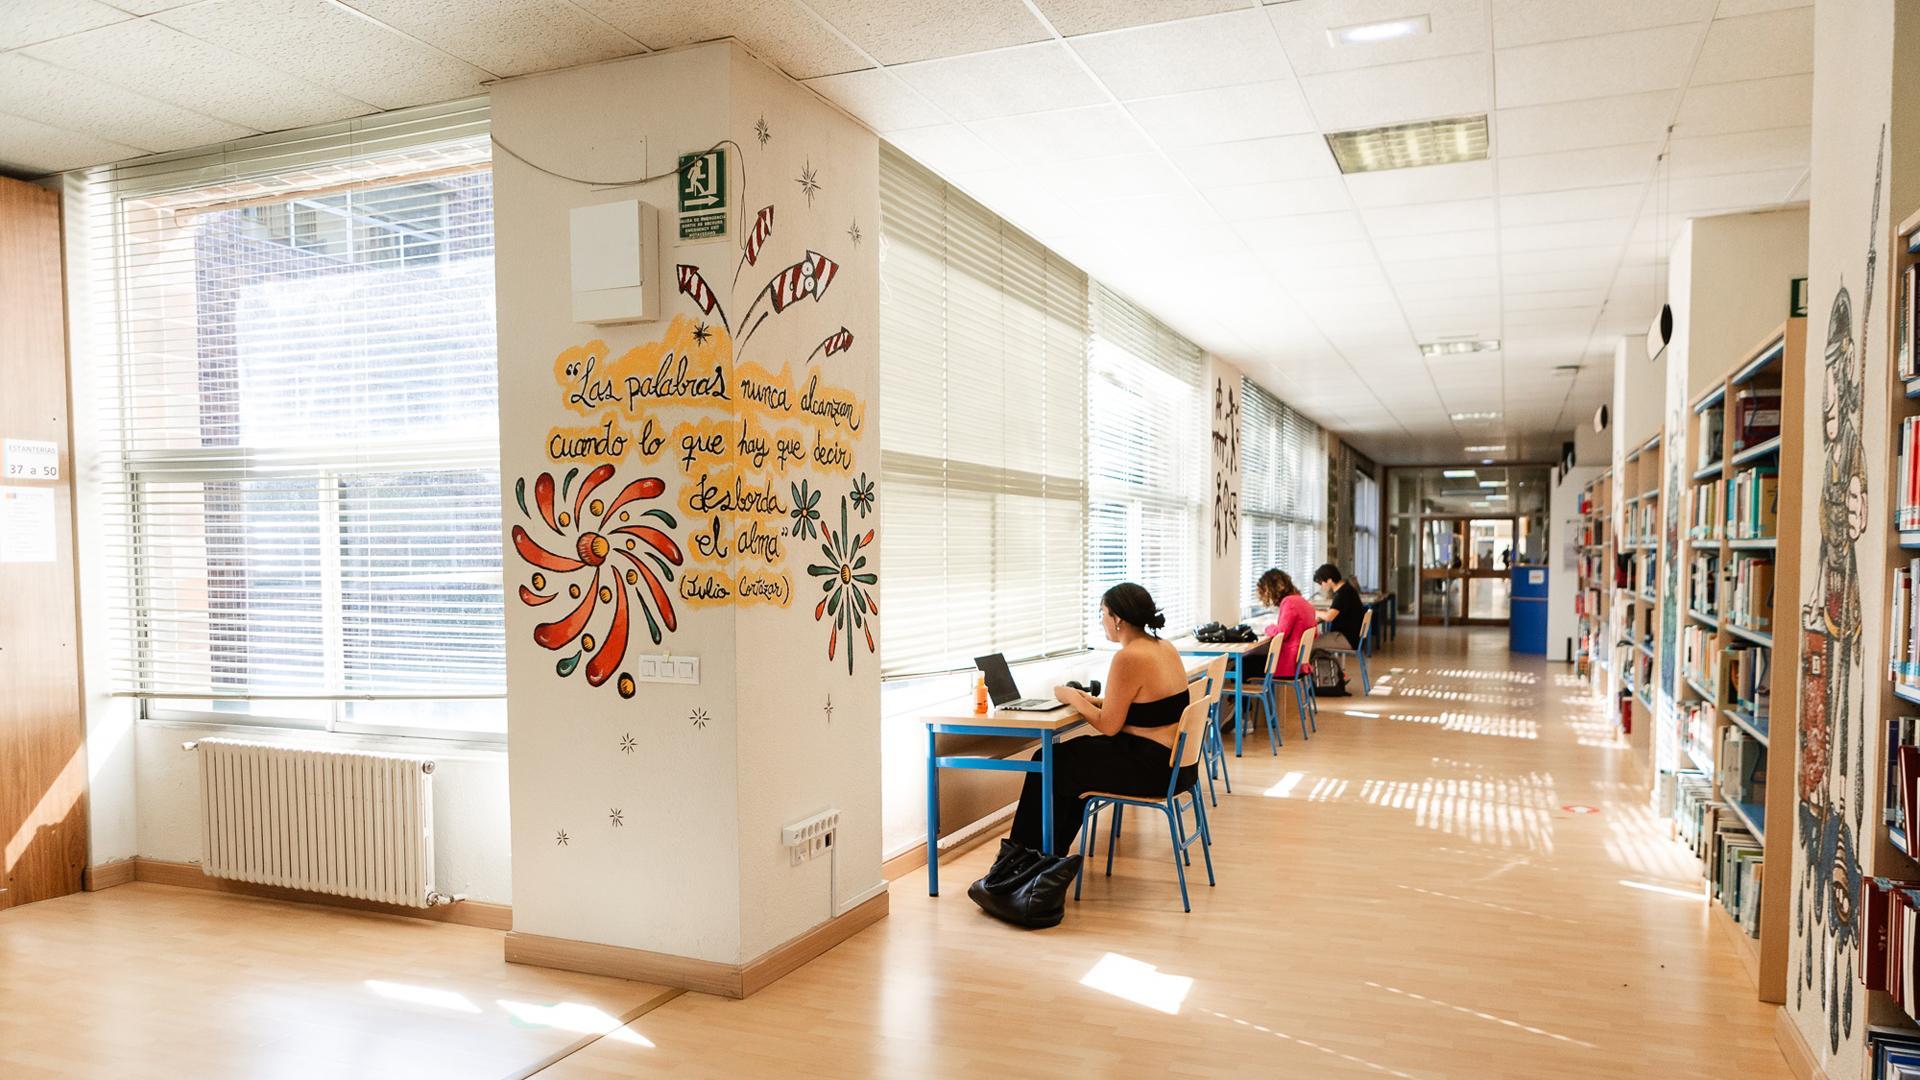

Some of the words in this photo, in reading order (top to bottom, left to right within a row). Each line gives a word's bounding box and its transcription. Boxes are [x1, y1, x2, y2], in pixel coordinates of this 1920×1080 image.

[624, 352, 732, 412] palabras
[740, 379, 793, 412] nunca
[800, 374, 861, 431] alcanzan
[550, 419, 628, 459] cuando
[639, 419, 666, 456] lo
[681, 434, 726, 472] que
[737, 418, 770, 468] hay
[776, 439, 807, 471] que
[813, 429, 852, 470] decir
[9, 464, 24, 475] 37
[29, 467, 37, 475] a
[43, 466, 57, 477] 50
[689, 474, 788, 514] desborda
[694, 515, 728, 558] el
[679, 574, 731, 600] (Julio
